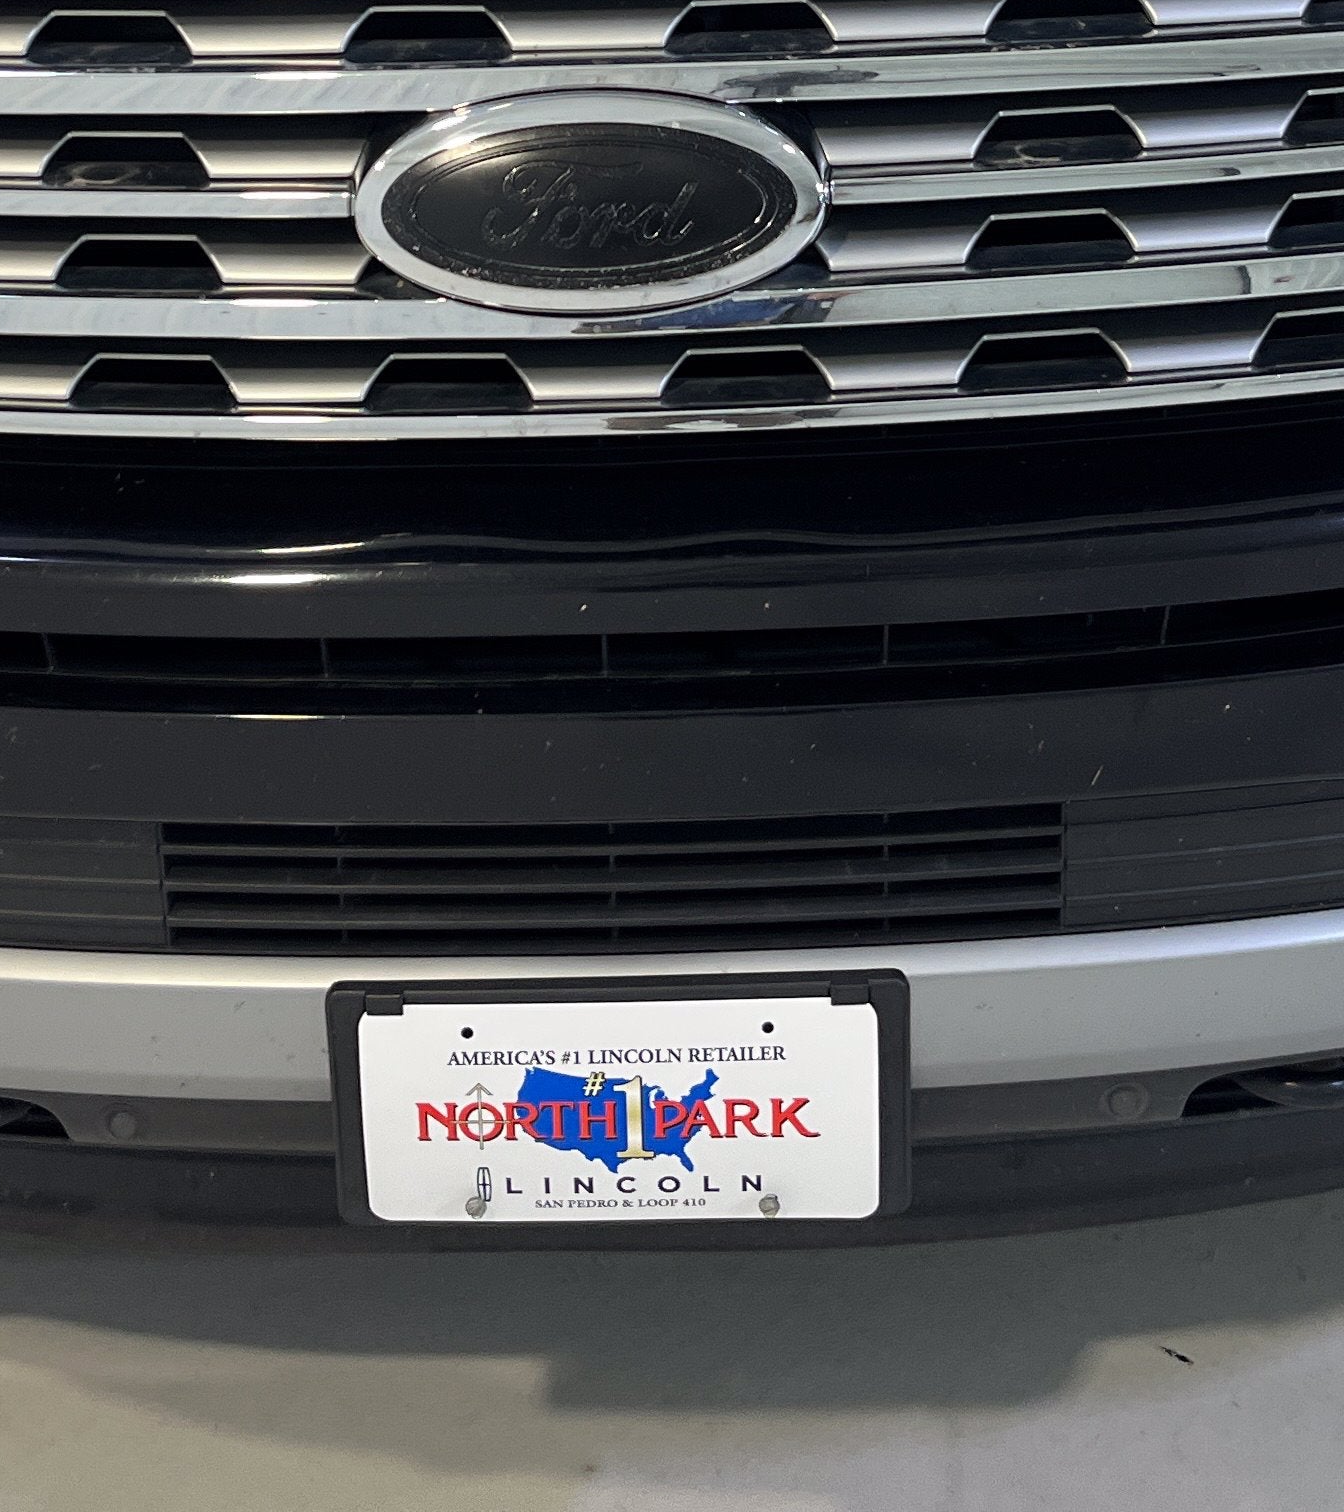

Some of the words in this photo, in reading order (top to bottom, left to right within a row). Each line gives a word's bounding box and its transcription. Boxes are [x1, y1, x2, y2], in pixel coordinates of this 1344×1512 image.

[481, 159, 699, 249] Ford
[446, 1050, 556, 1066] AMERICA'S
[561, 1050, 581, 1065] #1
[588, 1048, 682, 1065] LINCOLN
[688, 1046, 788, 1063] RETAILER
[415, 1098, 618, 1142] NORTH
[651, 1097, 821, 1140] PARK
[505, 1174, 763, 1194] LINCOLN
[534, 1199, 566, 1209] SAN
[568, 1199, 619, 1209] PEDRO
[622, 1199, 635, 1208] &
[637, 1198, 679, 1208] LOOP
[682, 1197, 706, 1207] 410
